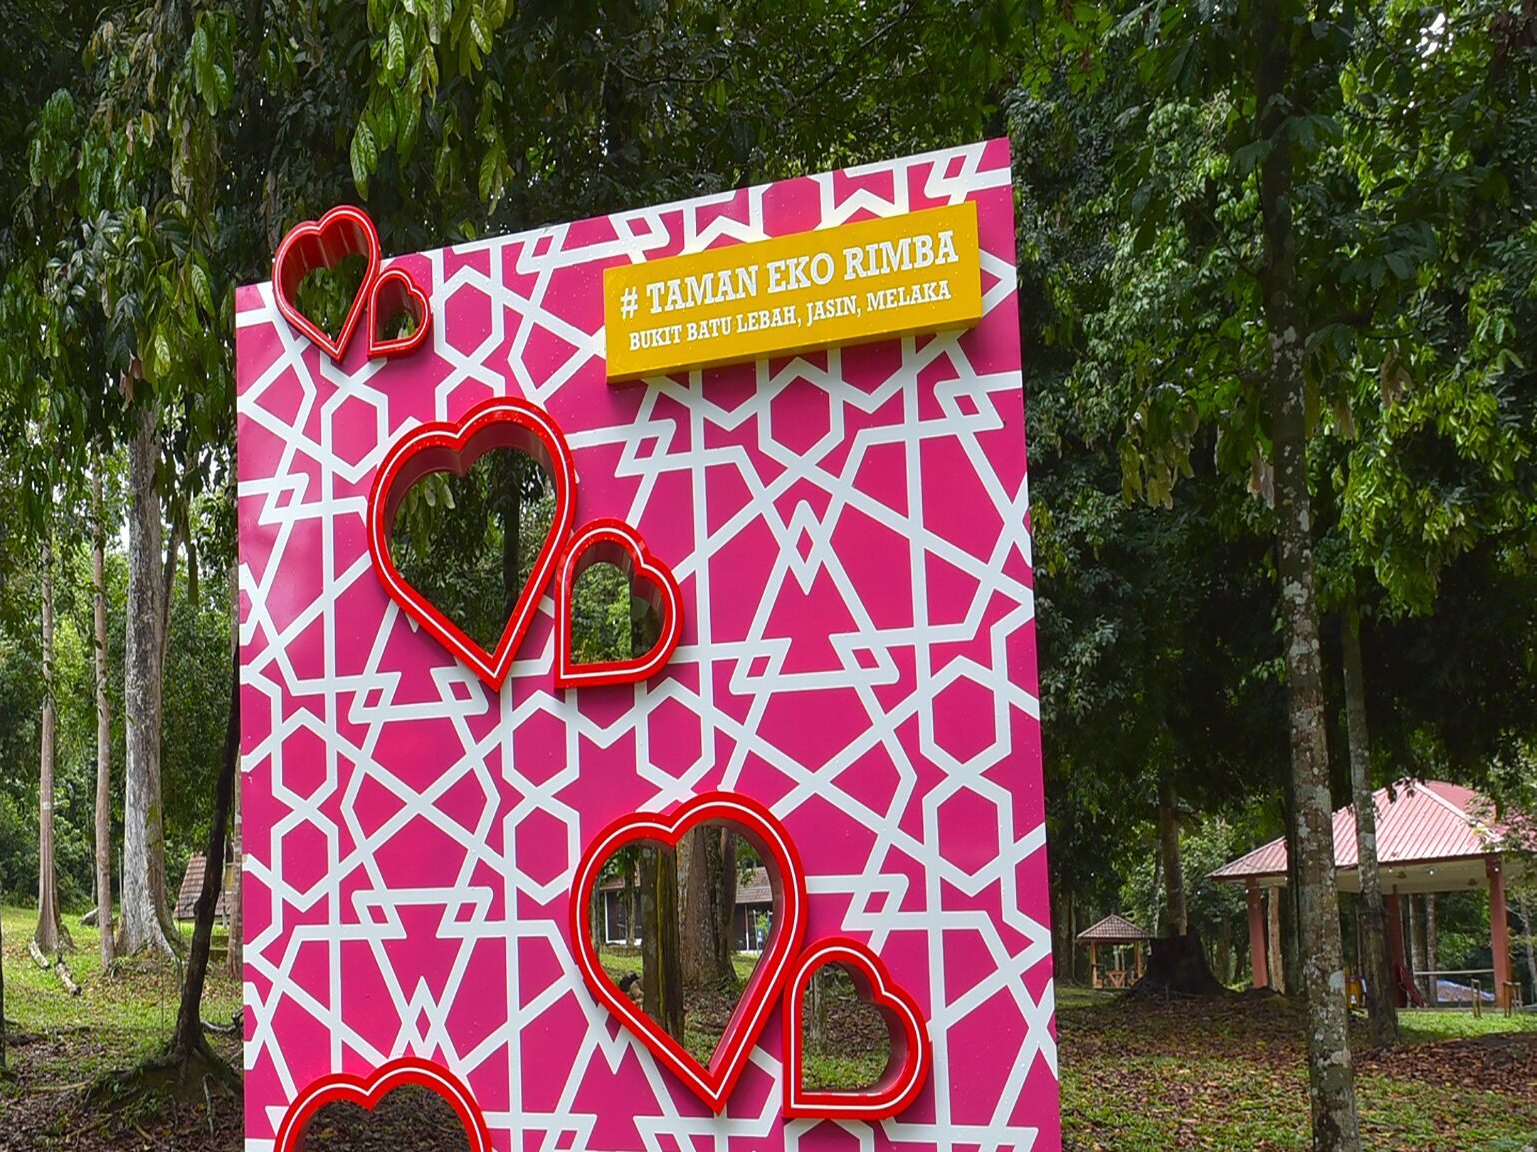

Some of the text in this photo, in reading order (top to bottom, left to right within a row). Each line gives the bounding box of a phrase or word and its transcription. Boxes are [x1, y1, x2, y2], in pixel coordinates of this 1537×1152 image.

[620, 230, 959, 320] # TAMAN EKO RIMBA
[629, 280, 951, 351] BUKIT BATU LEBAH, JASIN, MELAKA
